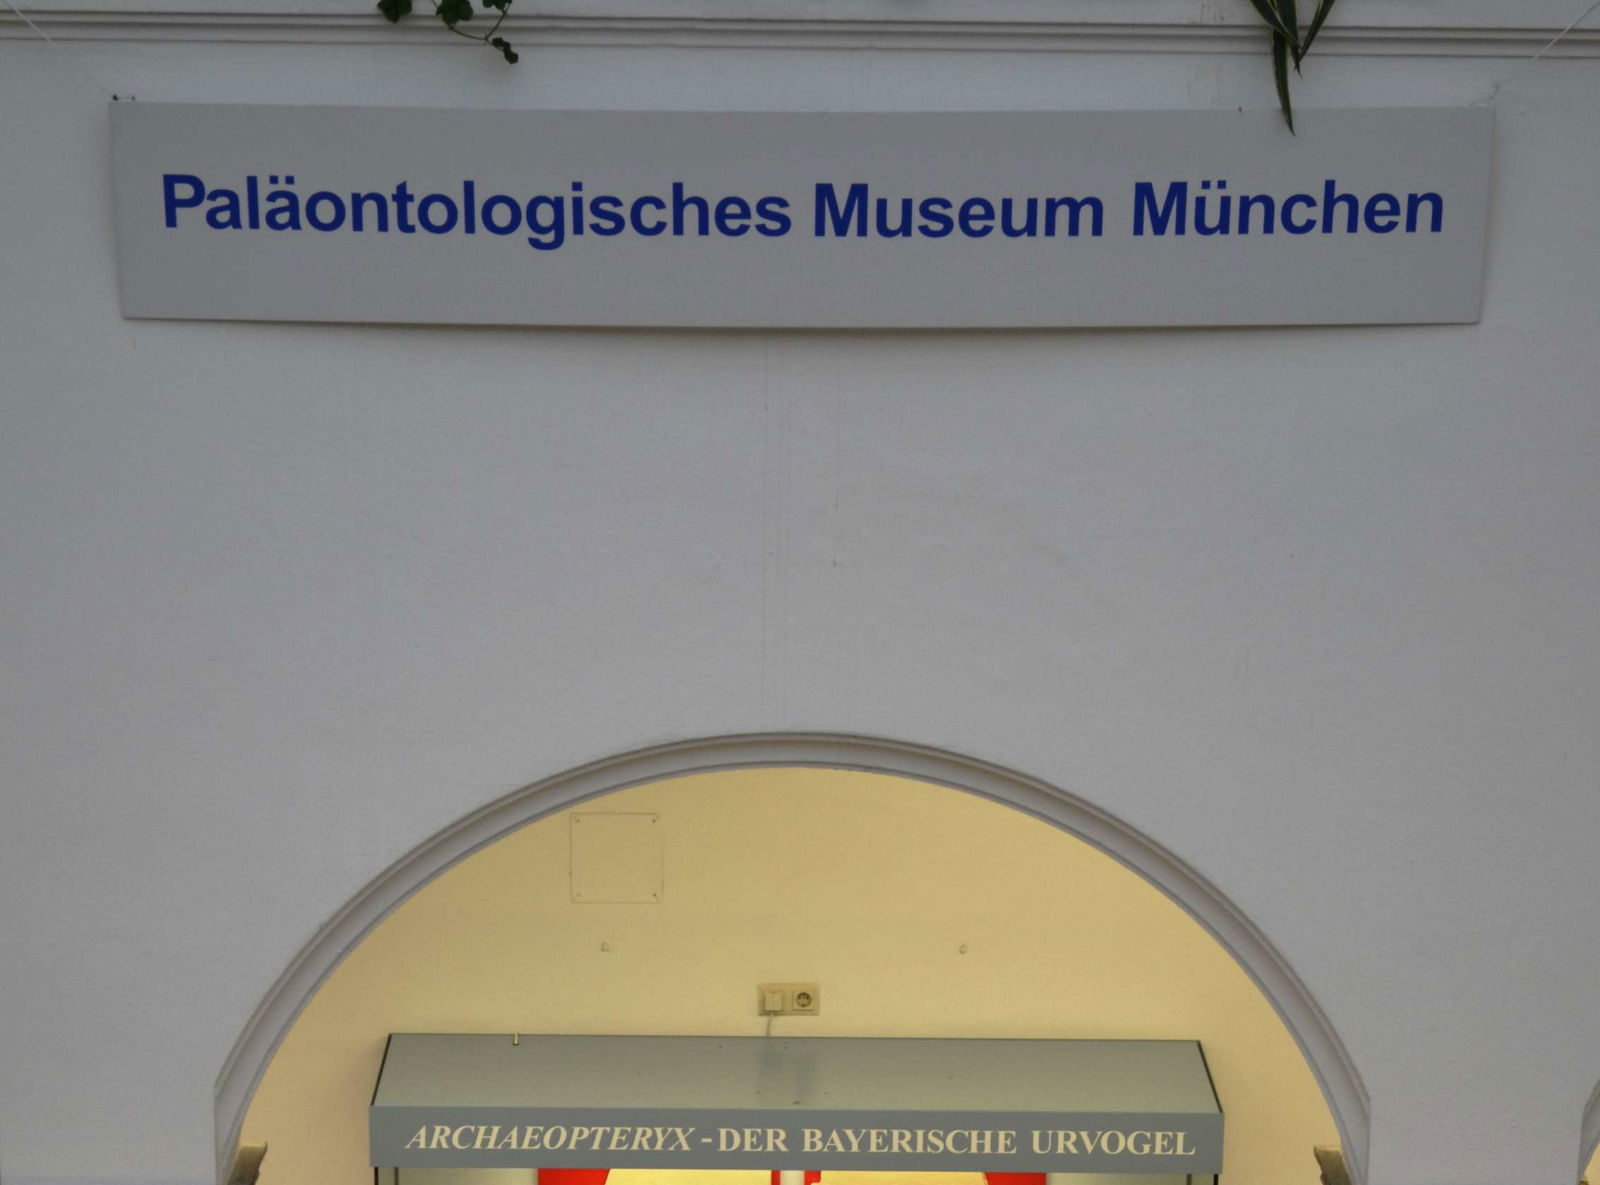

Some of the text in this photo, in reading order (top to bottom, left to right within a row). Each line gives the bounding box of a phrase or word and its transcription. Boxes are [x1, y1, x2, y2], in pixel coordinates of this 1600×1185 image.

[163, 174, 1444, 252] Paläontologisches Museum München
[405, 1125, 696, 1151] ARCHAEOPTERYX
[802, 1128, 1017, 1154] BAYERISCHE
[1031, 1130, 1196, 1156] URVOGEL
